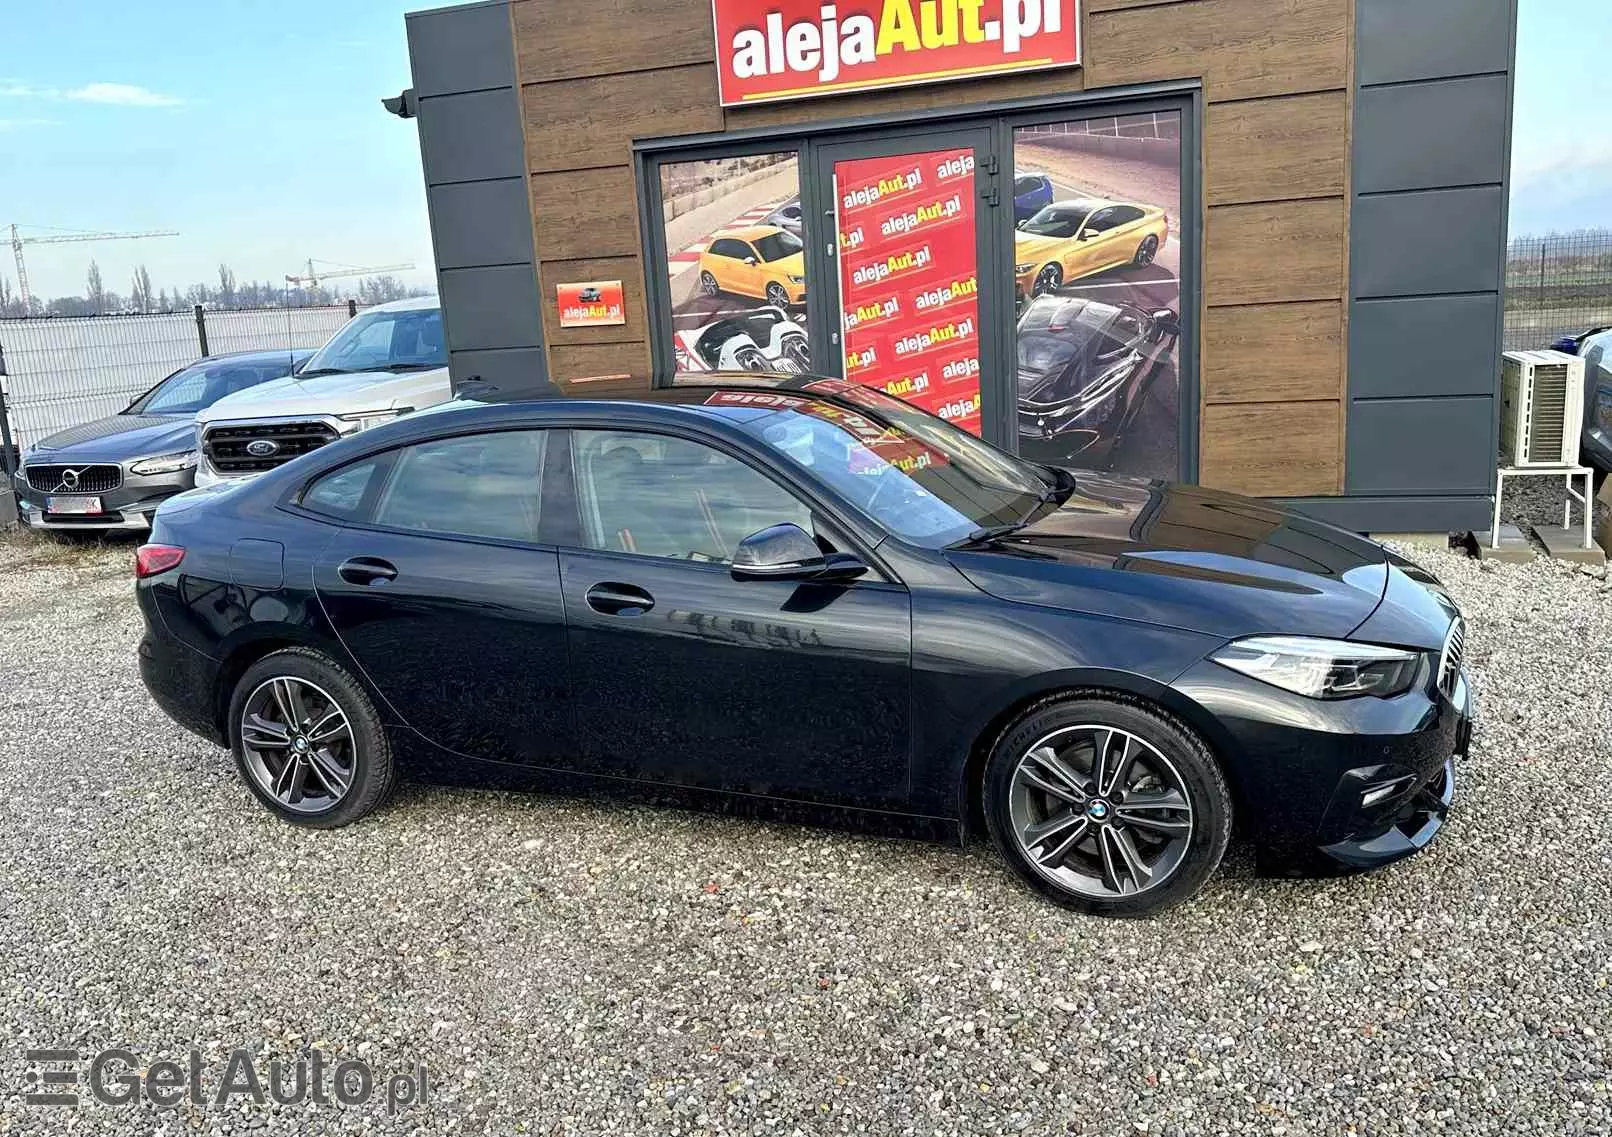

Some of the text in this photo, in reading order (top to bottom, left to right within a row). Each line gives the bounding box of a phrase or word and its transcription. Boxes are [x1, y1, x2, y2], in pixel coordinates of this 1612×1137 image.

[937, 155, 975, 179] aleja
[843, 168, 922, 208] alejaAut.pl
[881, 195, 961, 235] alejaAut.pl
[853, 246, 931, 285] alejaAut.pl
[563, 304, 621, 320] alejaAut.pl
[895, 318, 974, 354] alejaAut.pl
[942, 357, 980, 379] aleja
